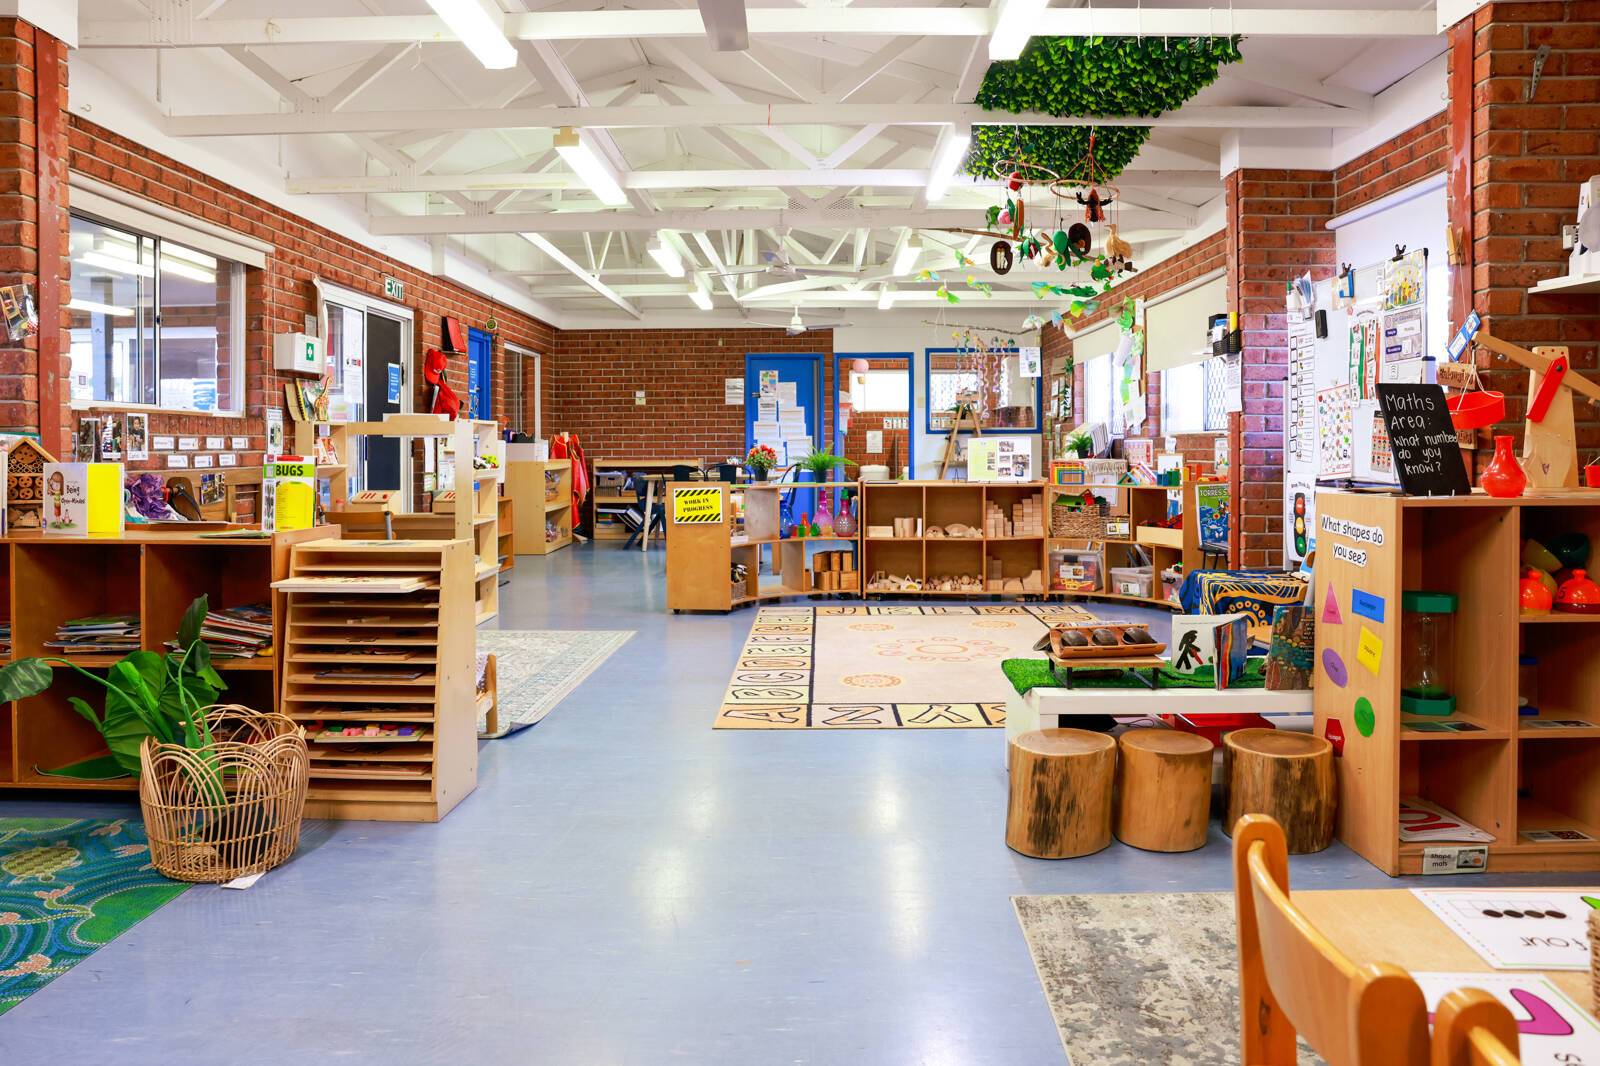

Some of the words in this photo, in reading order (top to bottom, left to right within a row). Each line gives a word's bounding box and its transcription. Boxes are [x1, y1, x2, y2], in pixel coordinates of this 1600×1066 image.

[386, 279, 404, 299] EXIT
[1385, 393, 1435, 411] Maths
[1391, 415, 1431, 430] Area:
[1393, 434, 1420, 446] What
[1398, 449, 1412, 460] do
[1422, 448, 1442, 463] you
[275, 465, 304, 477] BUGS
[1404, 461, 1441, 475] know?
[66, 484, 80, 496] Being
[1321, 516, 1341, 532] What
[1343, 521, 1371, 541] shapes
[1372, 528, 1383, 544] do
[1333, 544, 1347, 558] you
[1348, 550, 1367, 565] see?
[1430, 853, 1452, 861] Shape
[1432, 860, 1448, 868] mats
